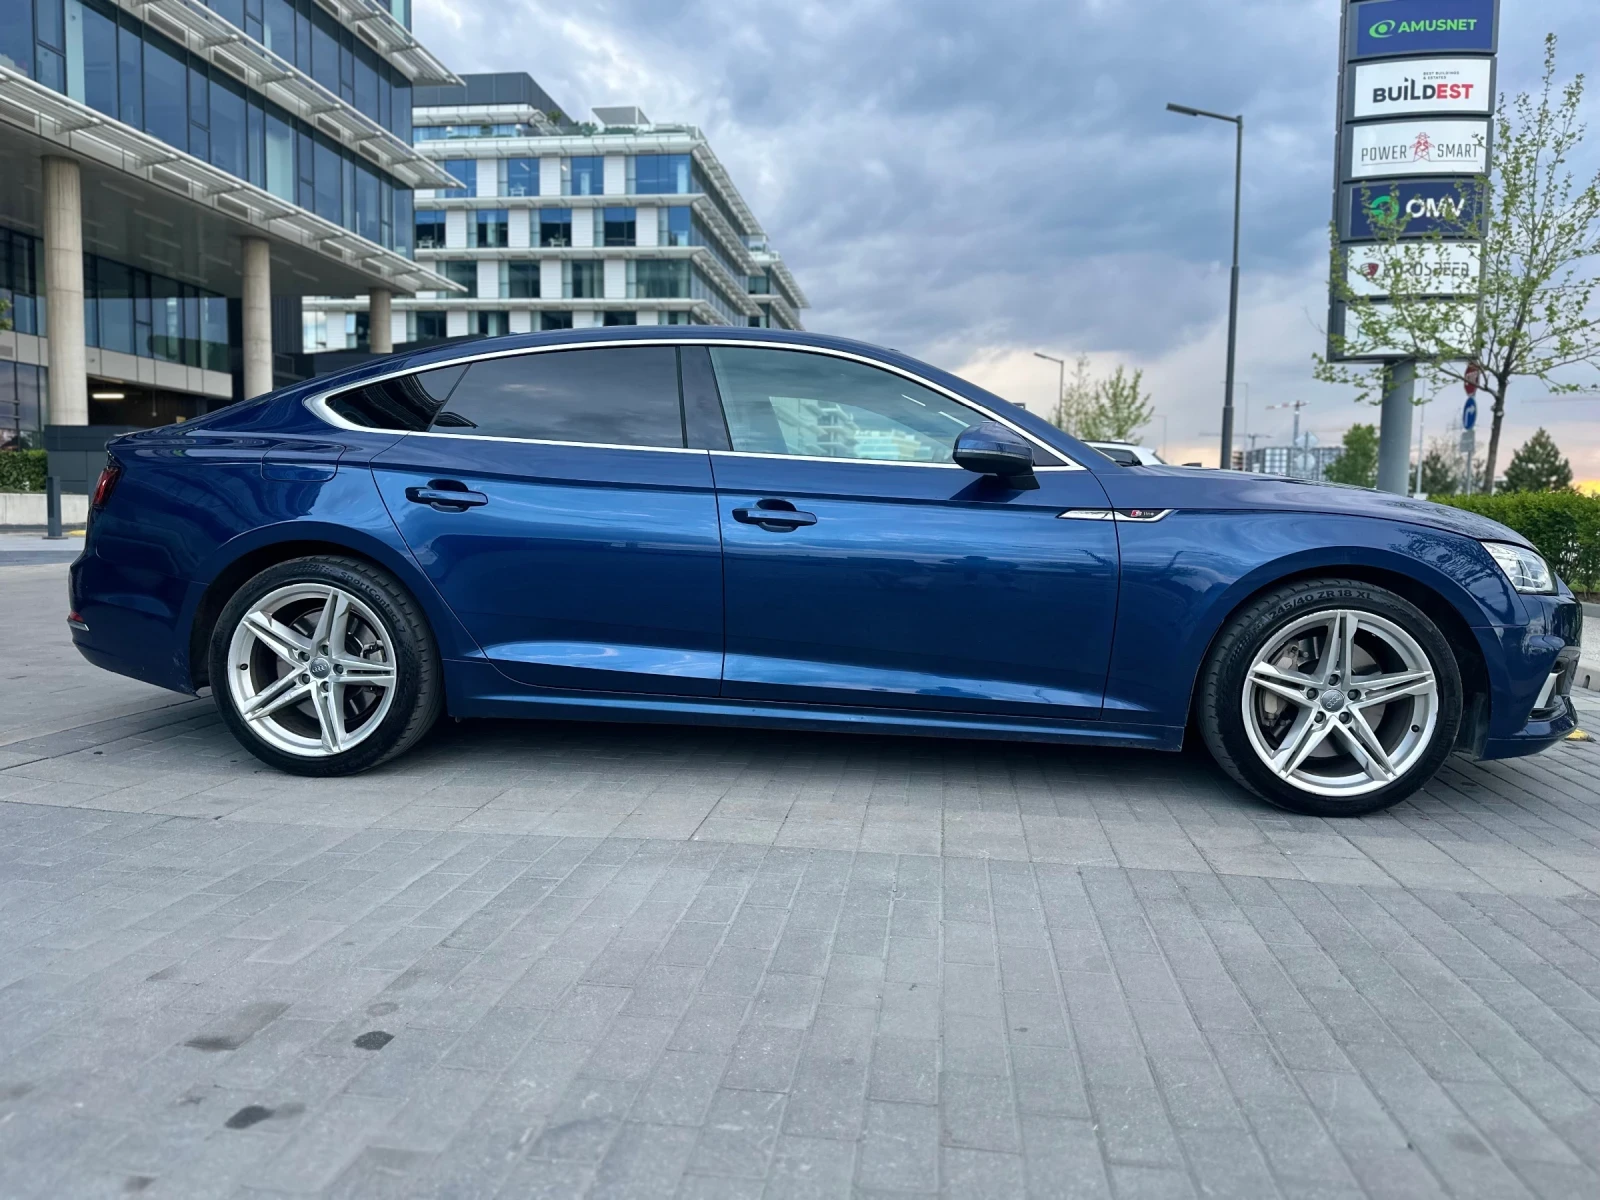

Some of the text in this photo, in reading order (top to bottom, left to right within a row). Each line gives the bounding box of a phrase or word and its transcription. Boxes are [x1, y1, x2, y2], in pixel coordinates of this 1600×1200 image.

[1398, 19, 1477, 33] AMUSNET
[1361, 143, 1478, 162] POWER SMART
[1406, 197, 1464, 218] OMV
[1270, 589, 1373, 620] 245/40 ZR 18 XL
